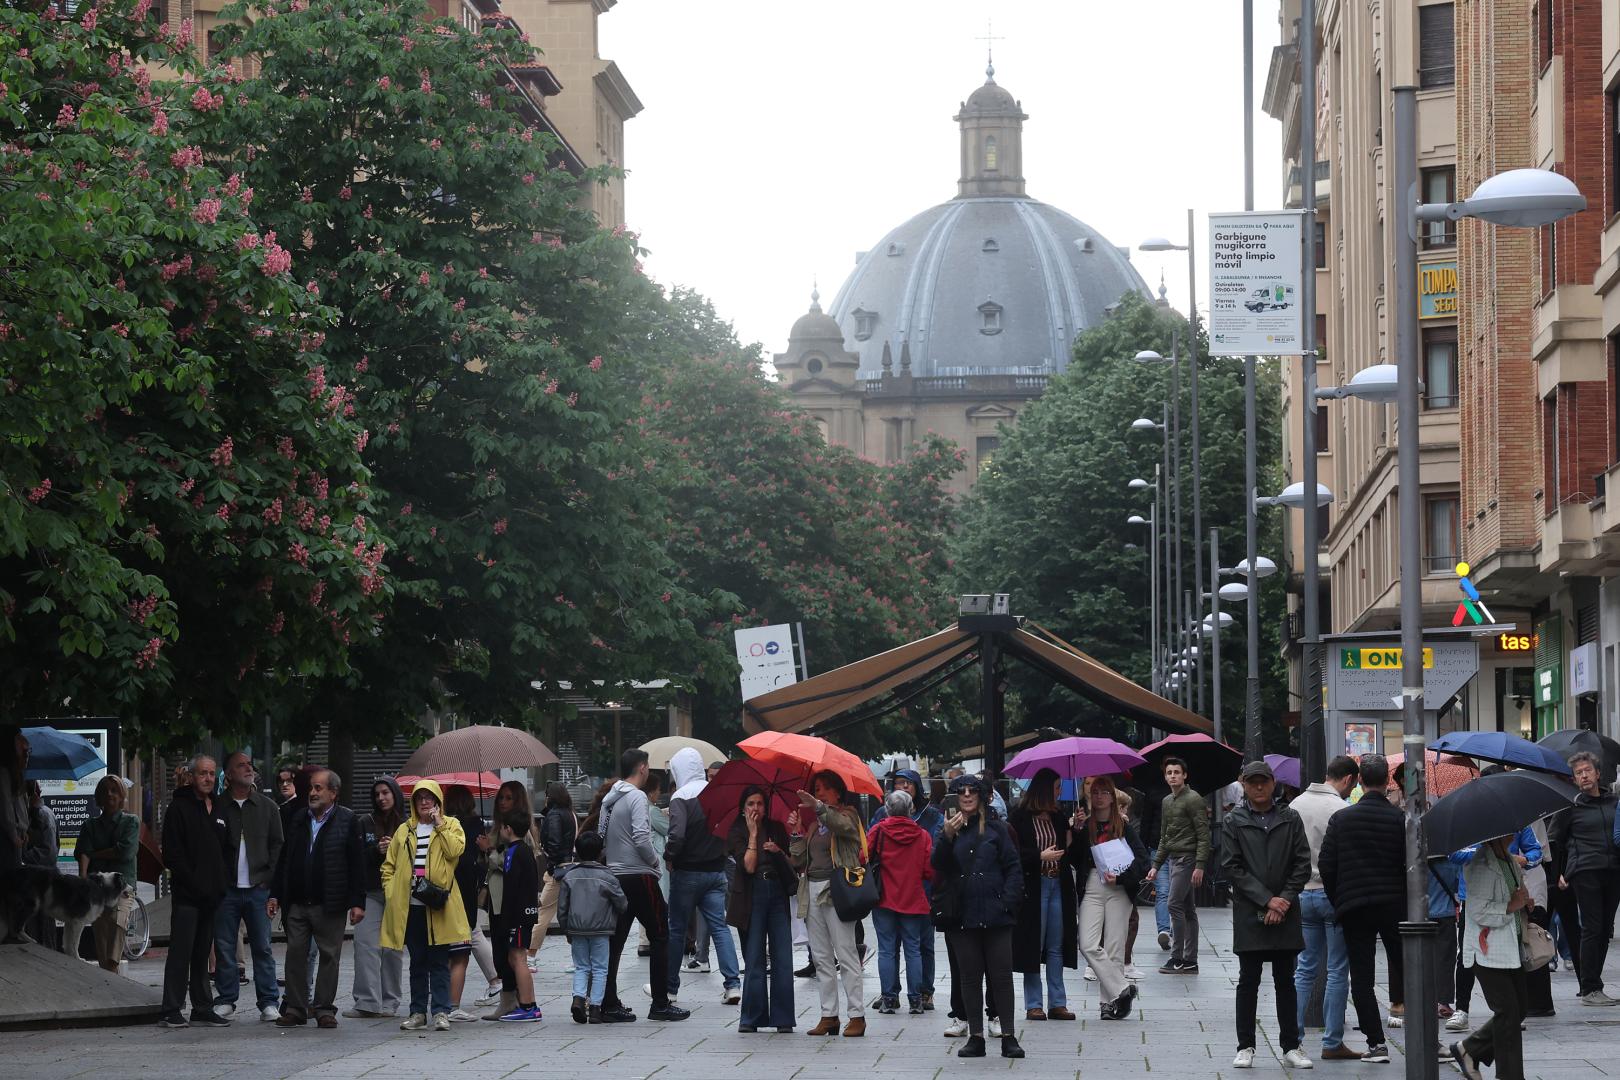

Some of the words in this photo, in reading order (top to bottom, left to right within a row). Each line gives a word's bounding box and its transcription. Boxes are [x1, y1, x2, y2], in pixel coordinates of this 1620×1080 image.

[1214, 232, 1266, 242] Garbigune
[1214, 241, 1266, 251] mugikorra
[1215, 252, 1242, 260] Punto
[1246, 252, 1276, 262] limpio
[1215, 260, 1242, 268] móvil
[1501, 633, 1530, 650] tas
[1368, 652, 1426, 666] ON
